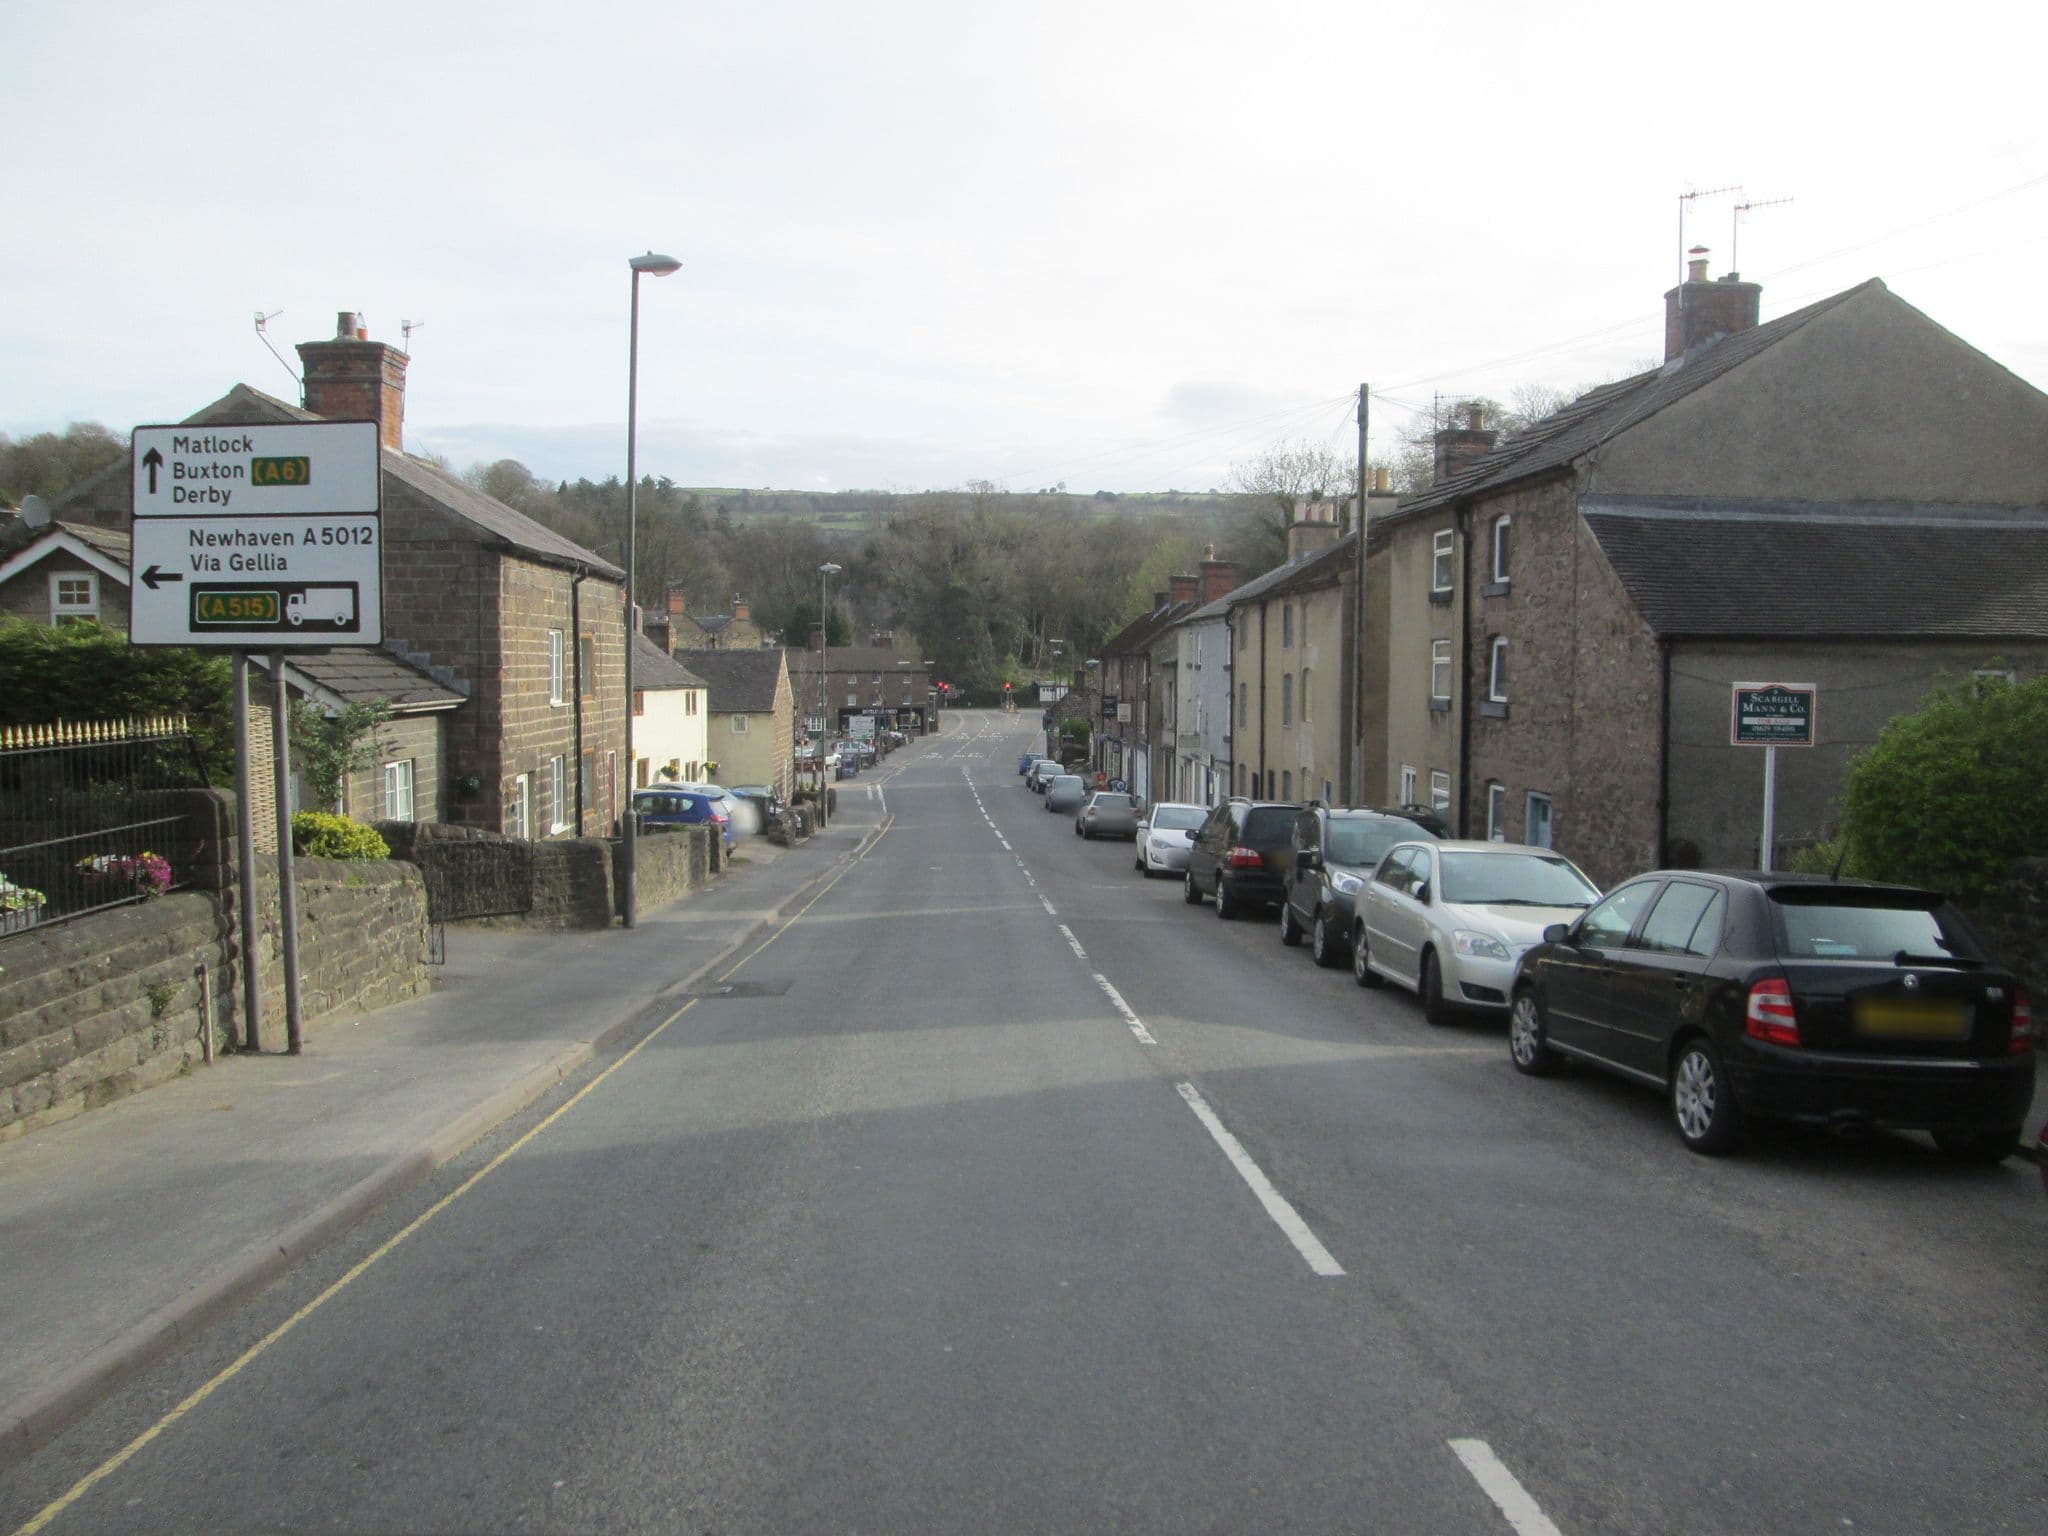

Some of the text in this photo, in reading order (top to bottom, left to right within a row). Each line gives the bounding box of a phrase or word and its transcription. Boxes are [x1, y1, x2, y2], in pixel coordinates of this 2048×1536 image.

[173, 435, 253, 454] Matlock
[173, 462, 244, 480] Buxton
[173, 486, 233, 507] Derby
[189, 529, 294, 547] Newhaven
[191, 553, 288, 571] Via Gellia
